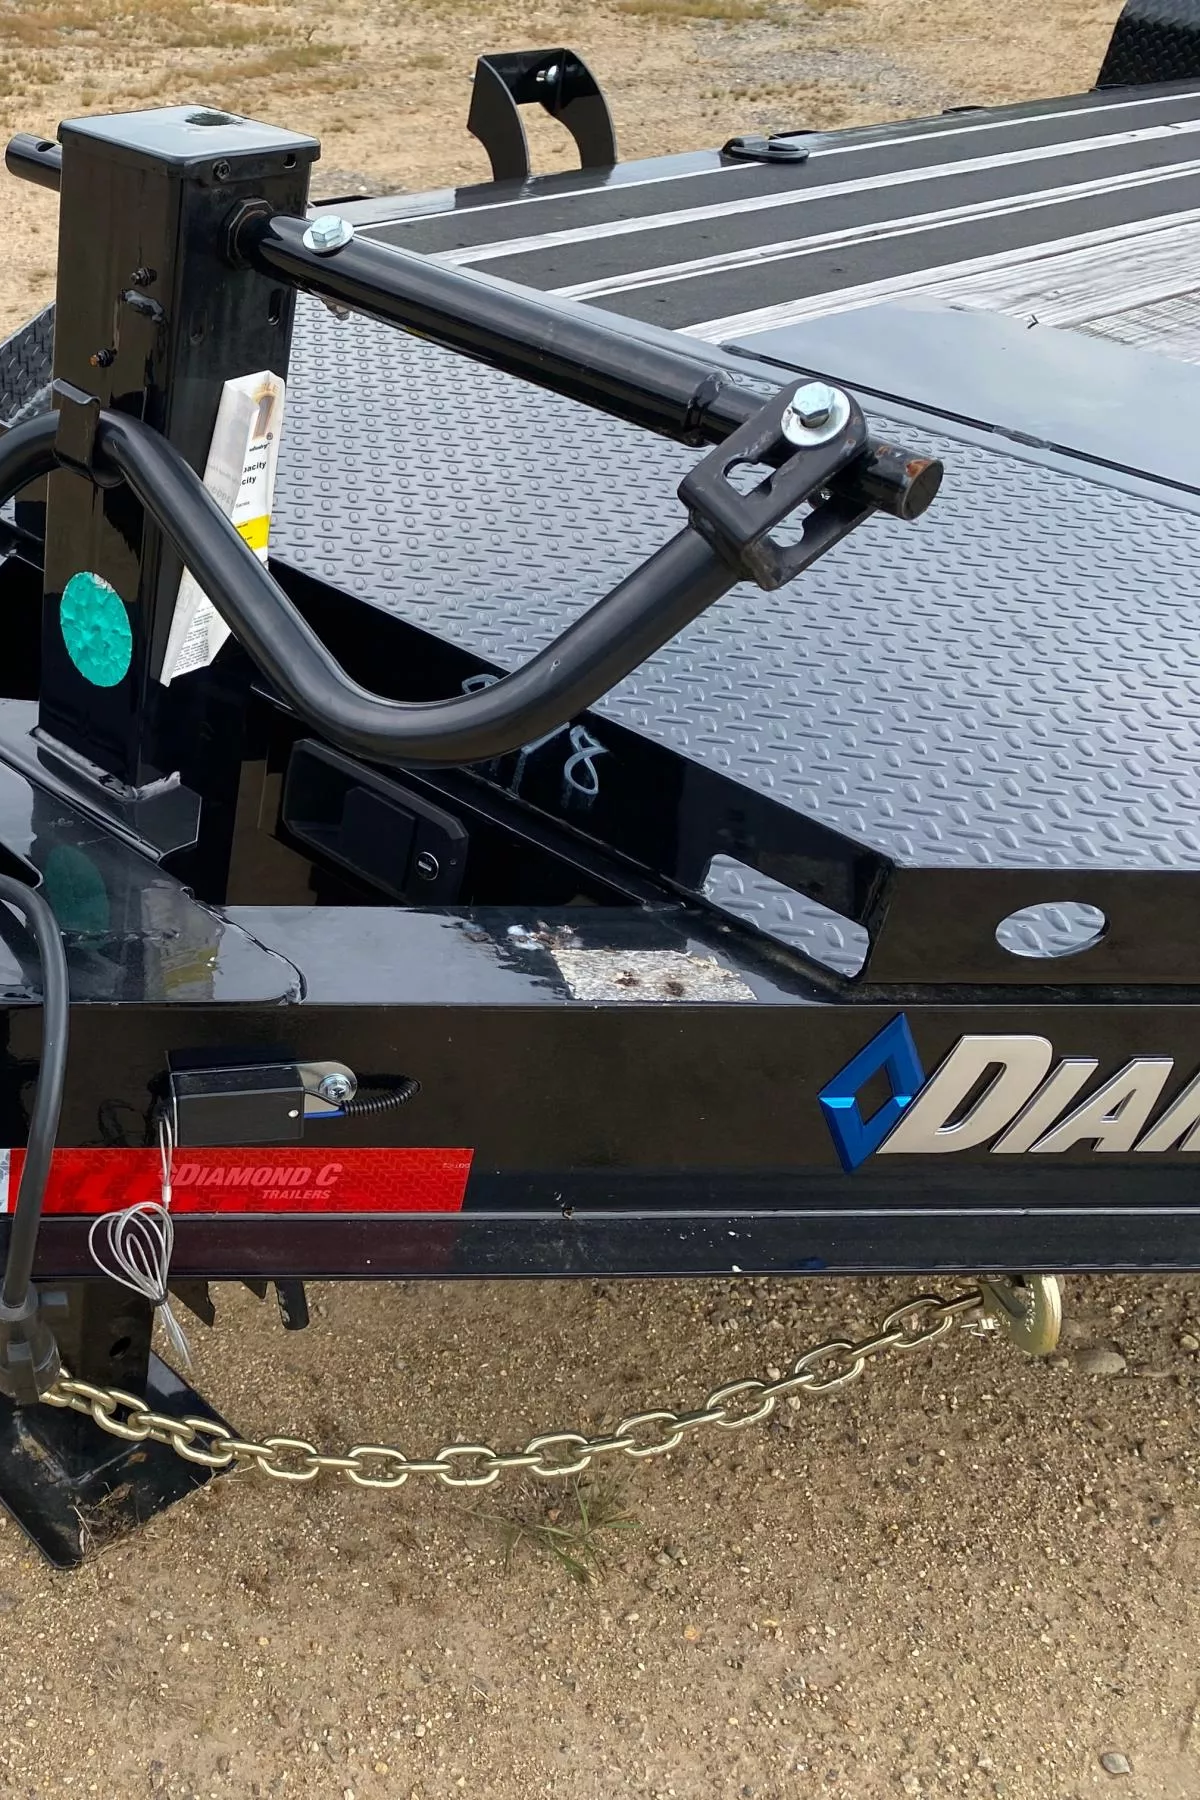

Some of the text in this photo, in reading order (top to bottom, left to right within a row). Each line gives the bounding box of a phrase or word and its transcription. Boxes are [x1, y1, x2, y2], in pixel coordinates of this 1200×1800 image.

[172, 1162, 344, 1187] DIAMOND C
[261, 1189, 331, 1200] TRAILERS
